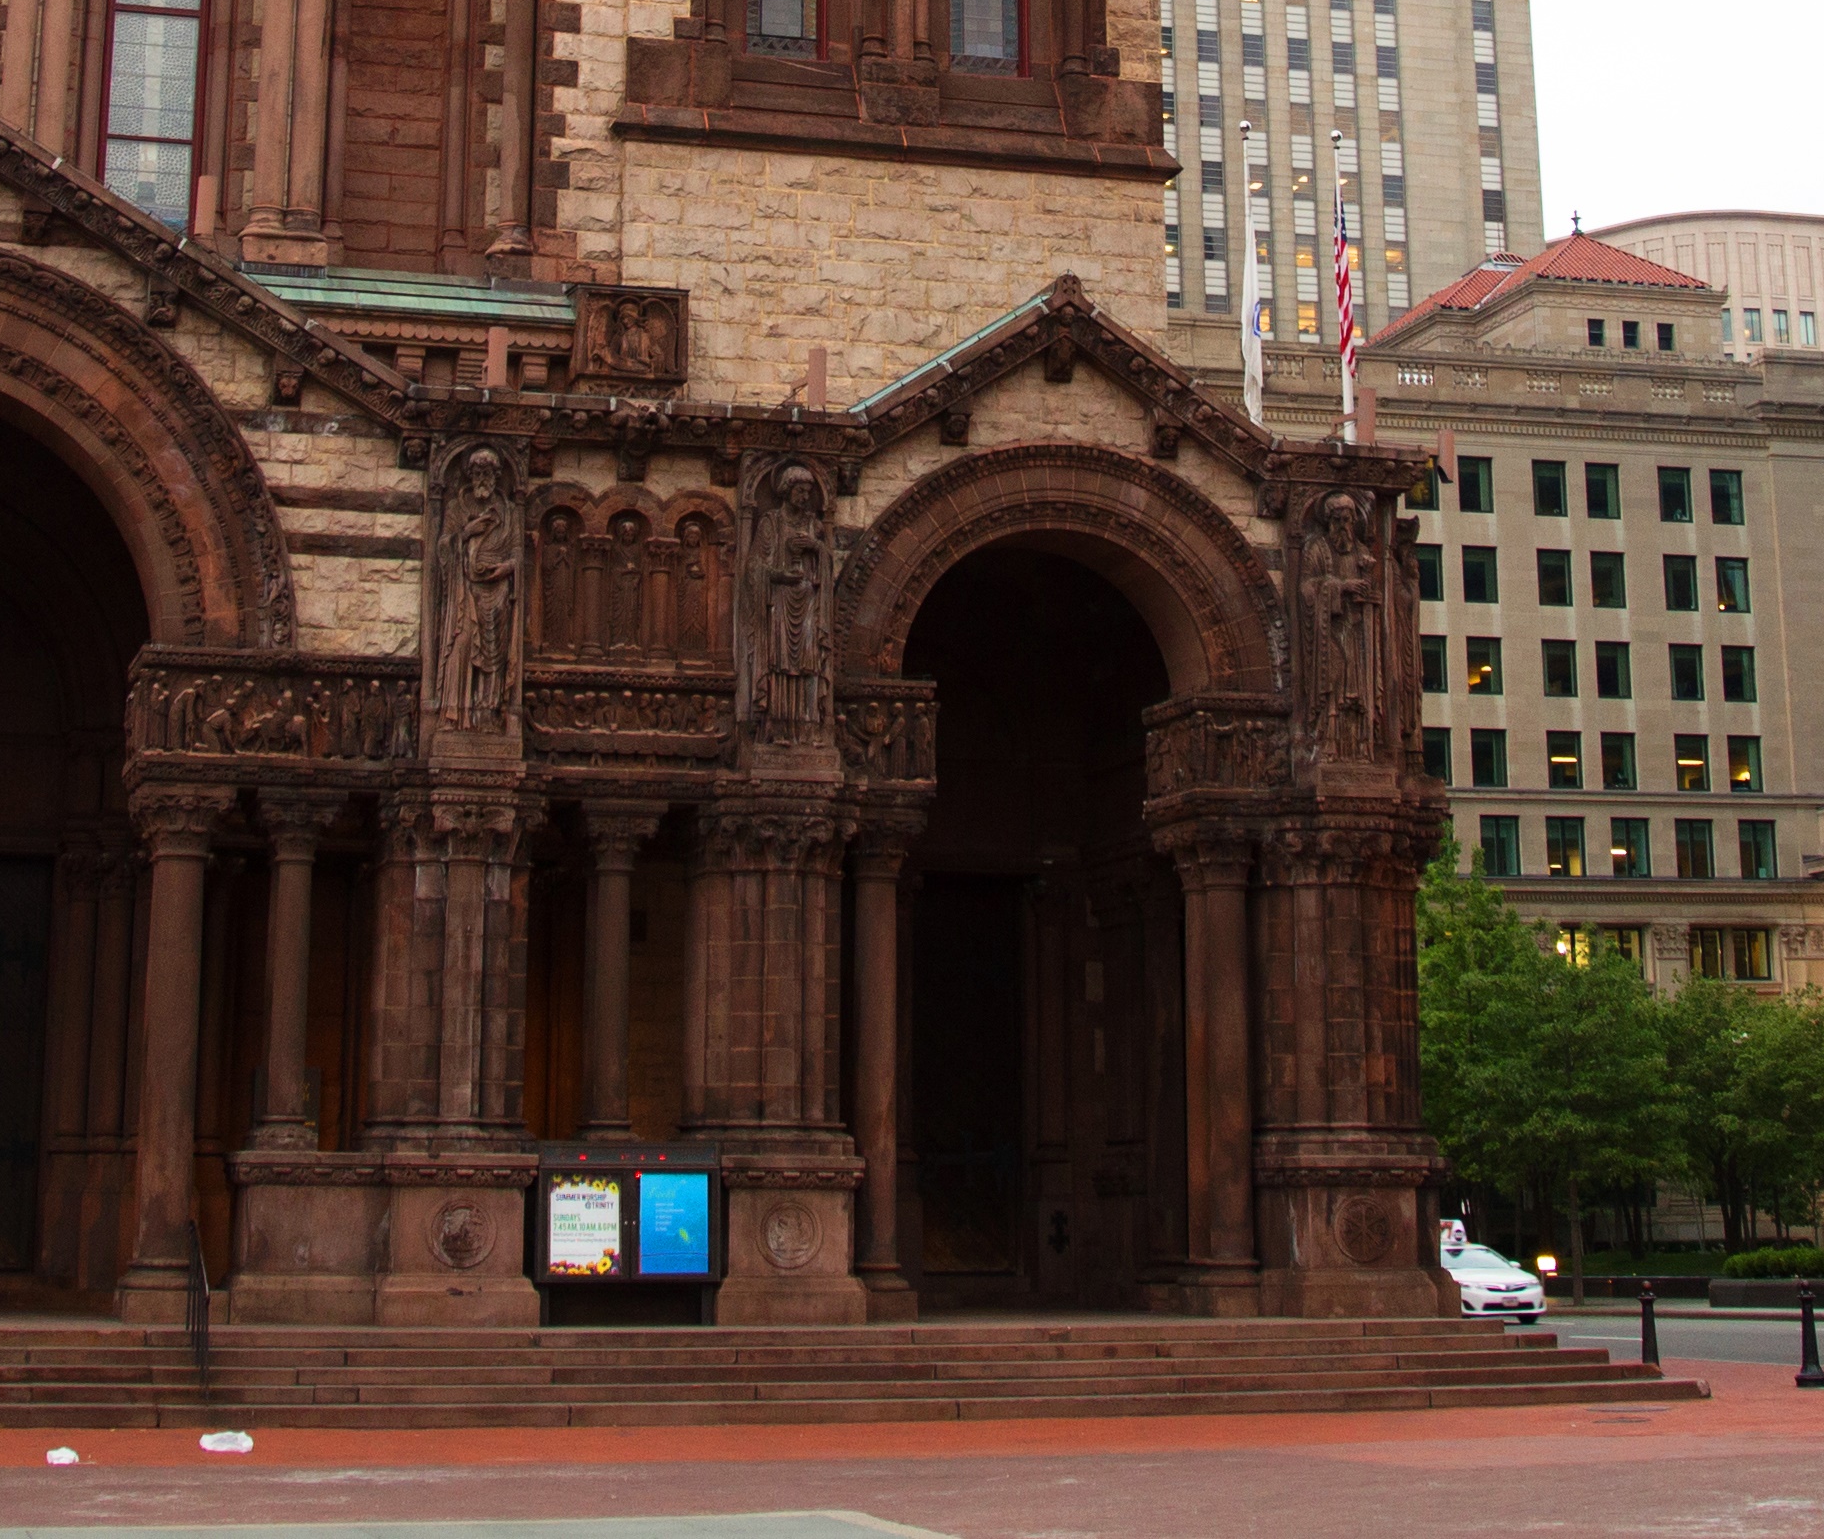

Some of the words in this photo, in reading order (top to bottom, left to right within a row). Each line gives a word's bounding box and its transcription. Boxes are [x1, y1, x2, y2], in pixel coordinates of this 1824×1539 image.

[555, 1193, 581, 1201] SUMMER
[582, 1193, 607, 1201] WORSHIP
[553, 1213, 581, 1222] SUNDAYS
